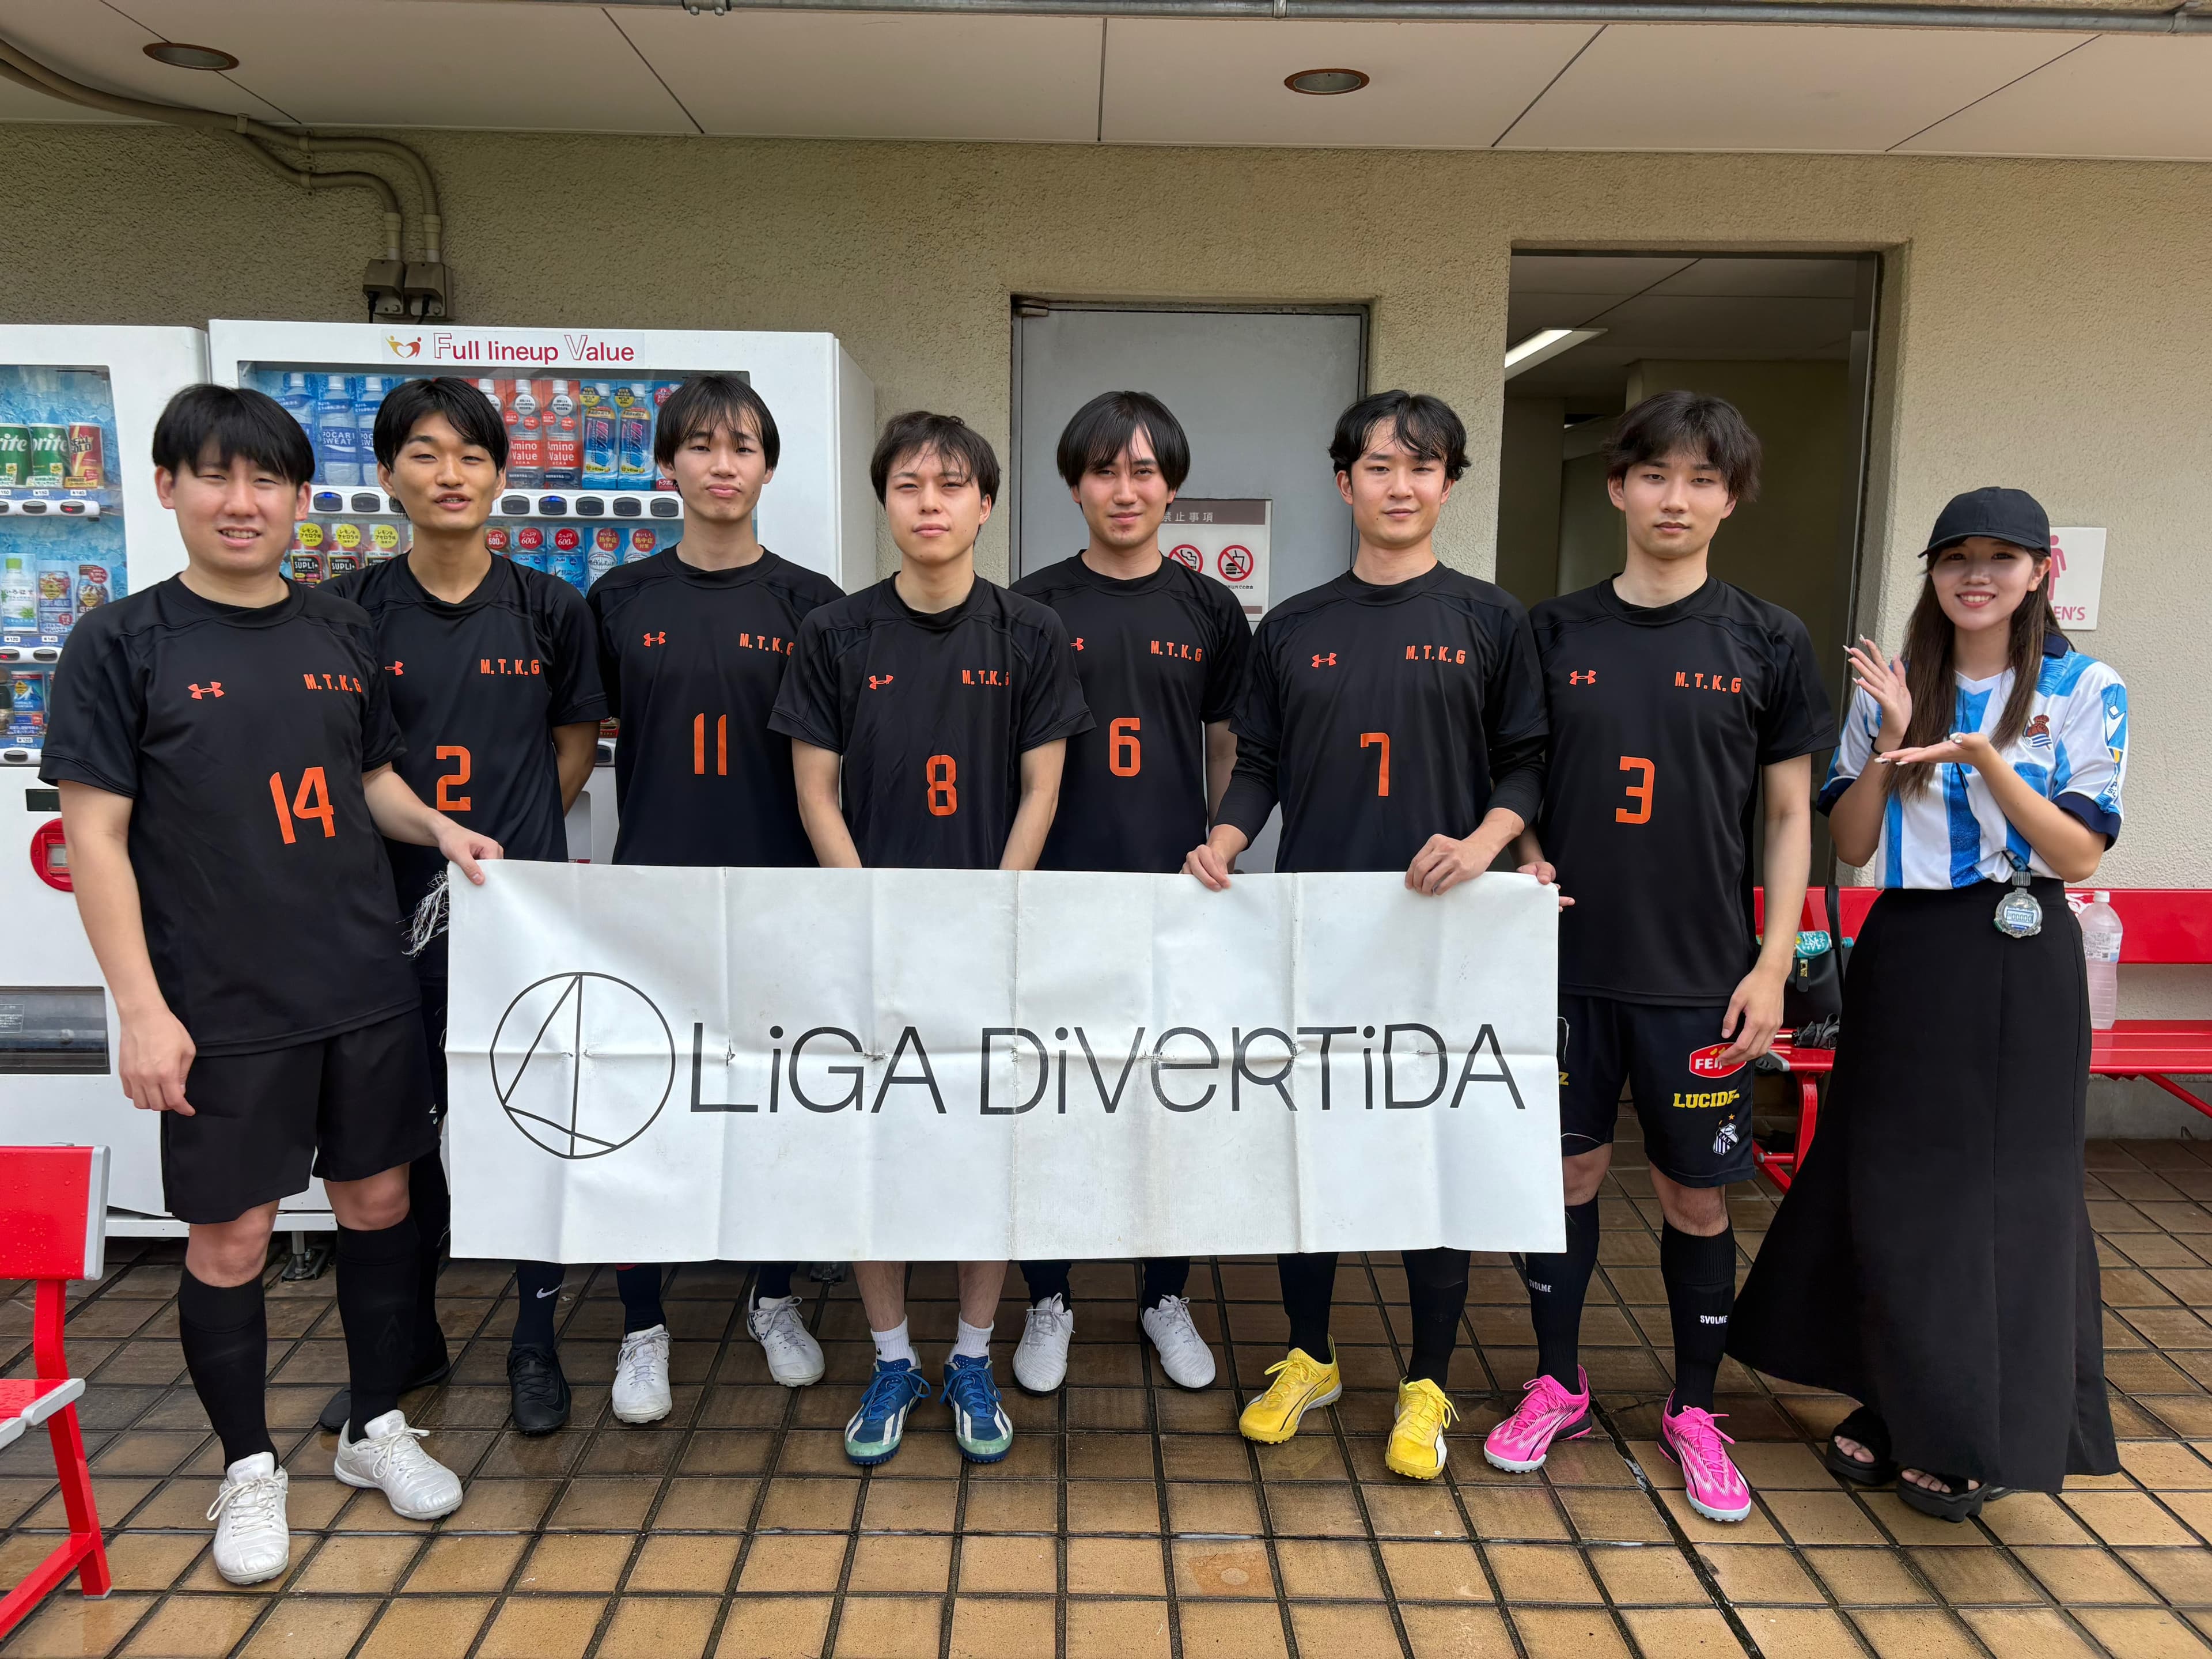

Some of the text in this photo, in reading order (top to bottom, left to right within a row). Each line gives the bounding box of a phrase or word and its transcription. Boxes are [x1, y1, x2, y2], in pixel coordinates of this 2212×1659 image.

[433, 332, 635, 365] Full lineup Value
[0, 433, 28, 452] rite
[510, 441, 537, 450] Amino
[548, 441, 574, 450] Amino
[512, 452, 537, 460] Value
[549, 452, 574, 461] Value
[1162, 511, 1213, 522] 禁止事項
[2054, 606, 2085, 620] EN'S
[694, 713, 727, 776] 11
[1109, 717, 1141, 777] 6
[1361, 732, 1391, 797] 7
[436, 745, 471, 811] 2
[926, 754, 957, 816] 8
[1615, 756, 1656, 824] 3
[270, 766, 336, 844] 14
[1700, 1315, 1728, 1324] SVOLME
